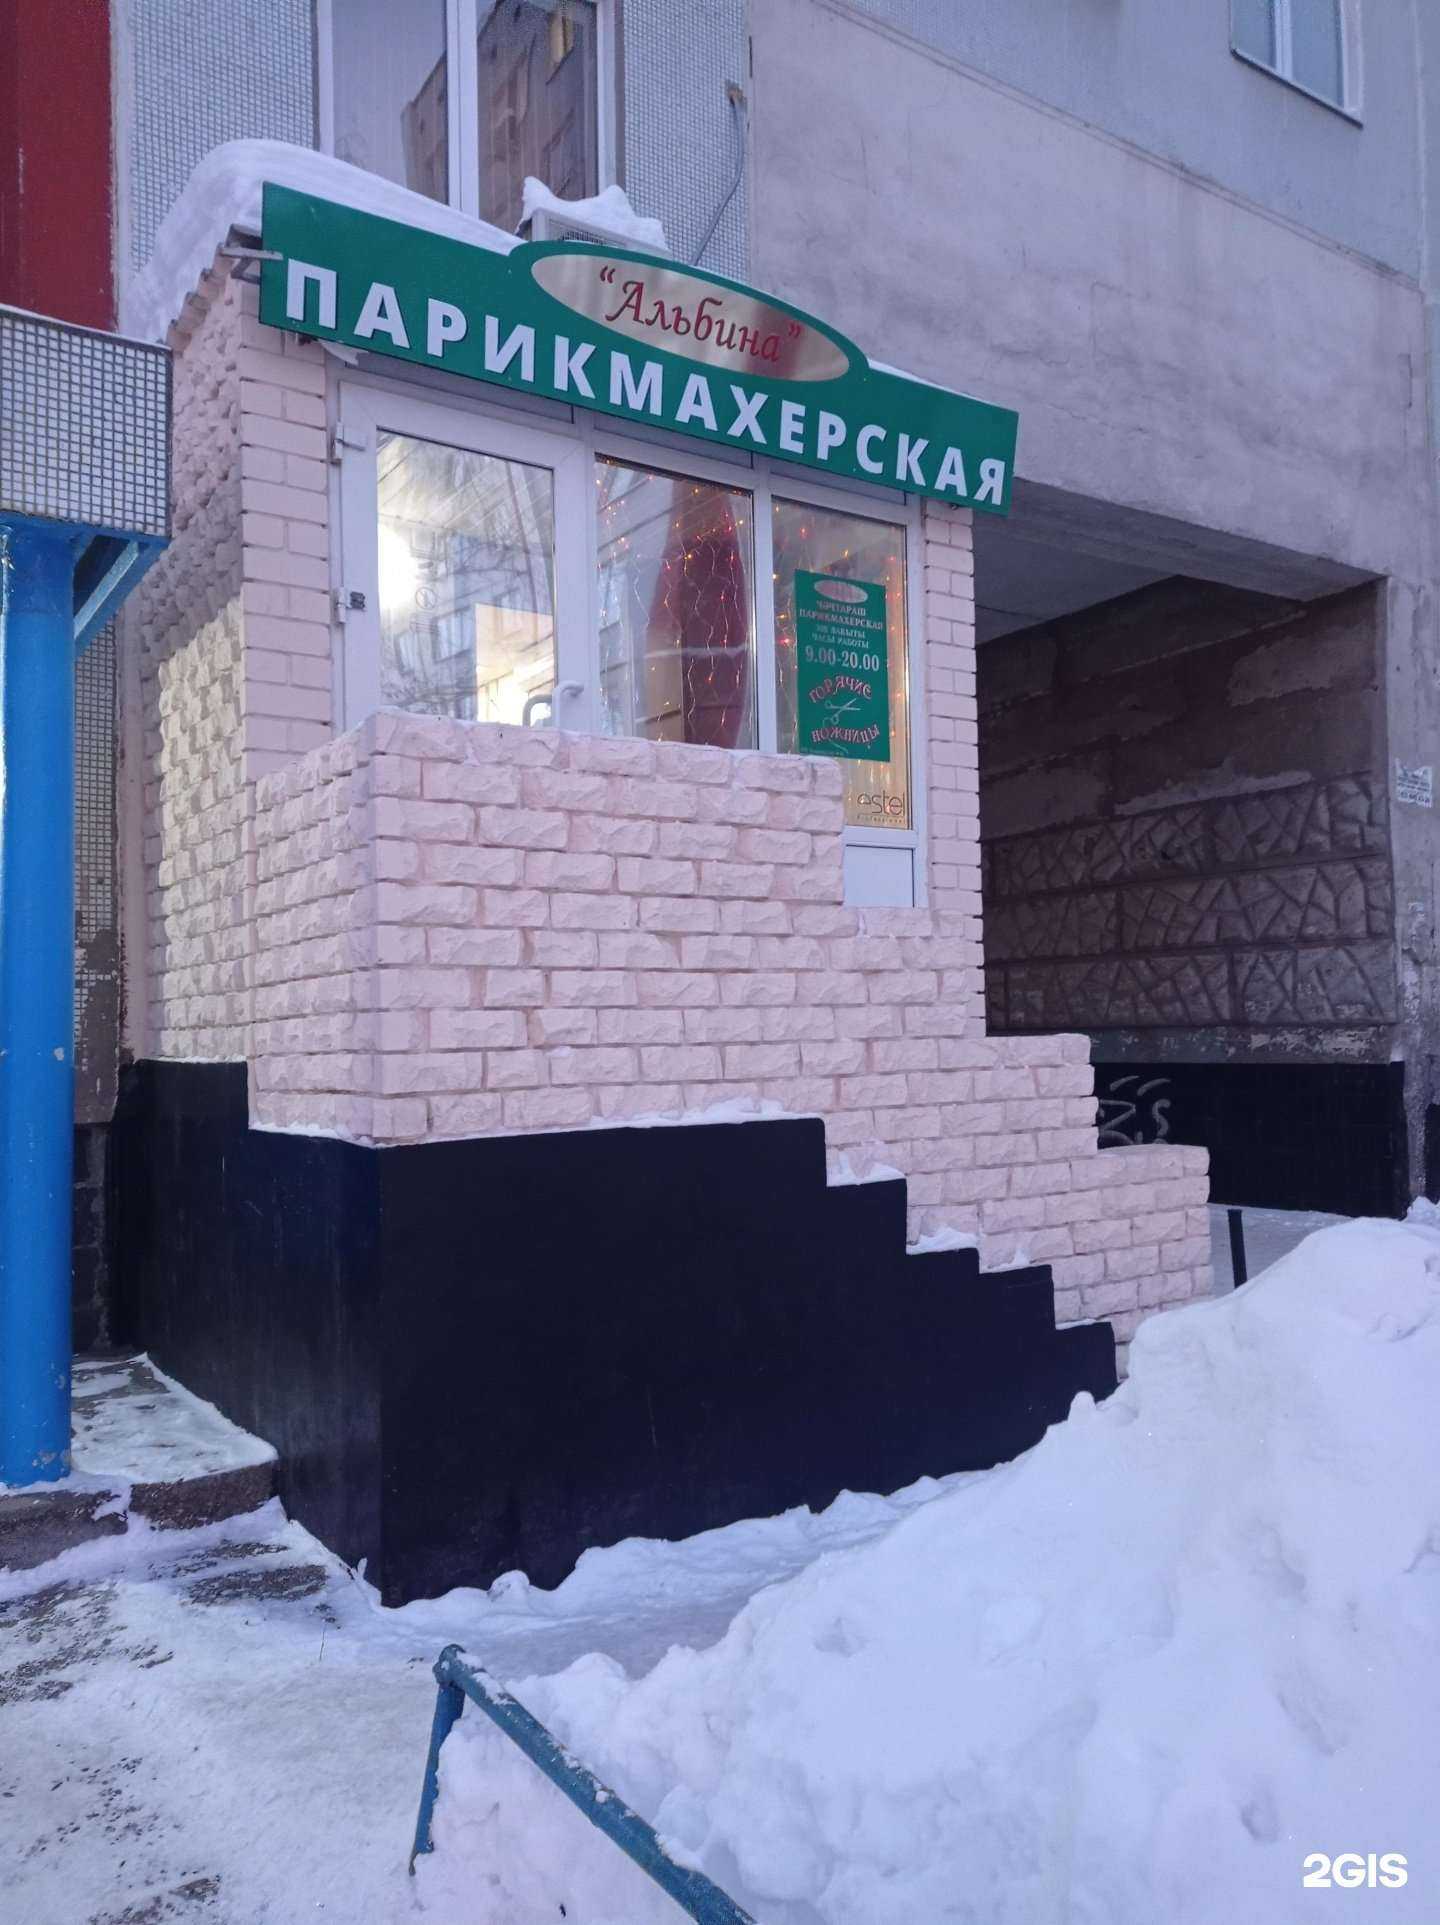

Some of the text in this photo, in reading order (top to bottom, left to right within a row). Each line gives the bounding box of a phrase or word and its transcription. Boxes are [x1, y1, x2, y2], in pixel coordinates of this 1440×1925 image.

[285, 257, 1007, 508] ПАРИКМАХЕРСКАЯ
[800, 608, 883, 631] ПАРИКМАХЕРСКАЯ
[837, 637, 869, 649] РАБОТЫ
[805, 645, 880, 672] 9.00-20.00
[809, 675, 873, 703] ГОРЯЧИЕ
[811, 723, 880, 750] НОЖНИЦЫ
[857, 790, 905, 816] estel
